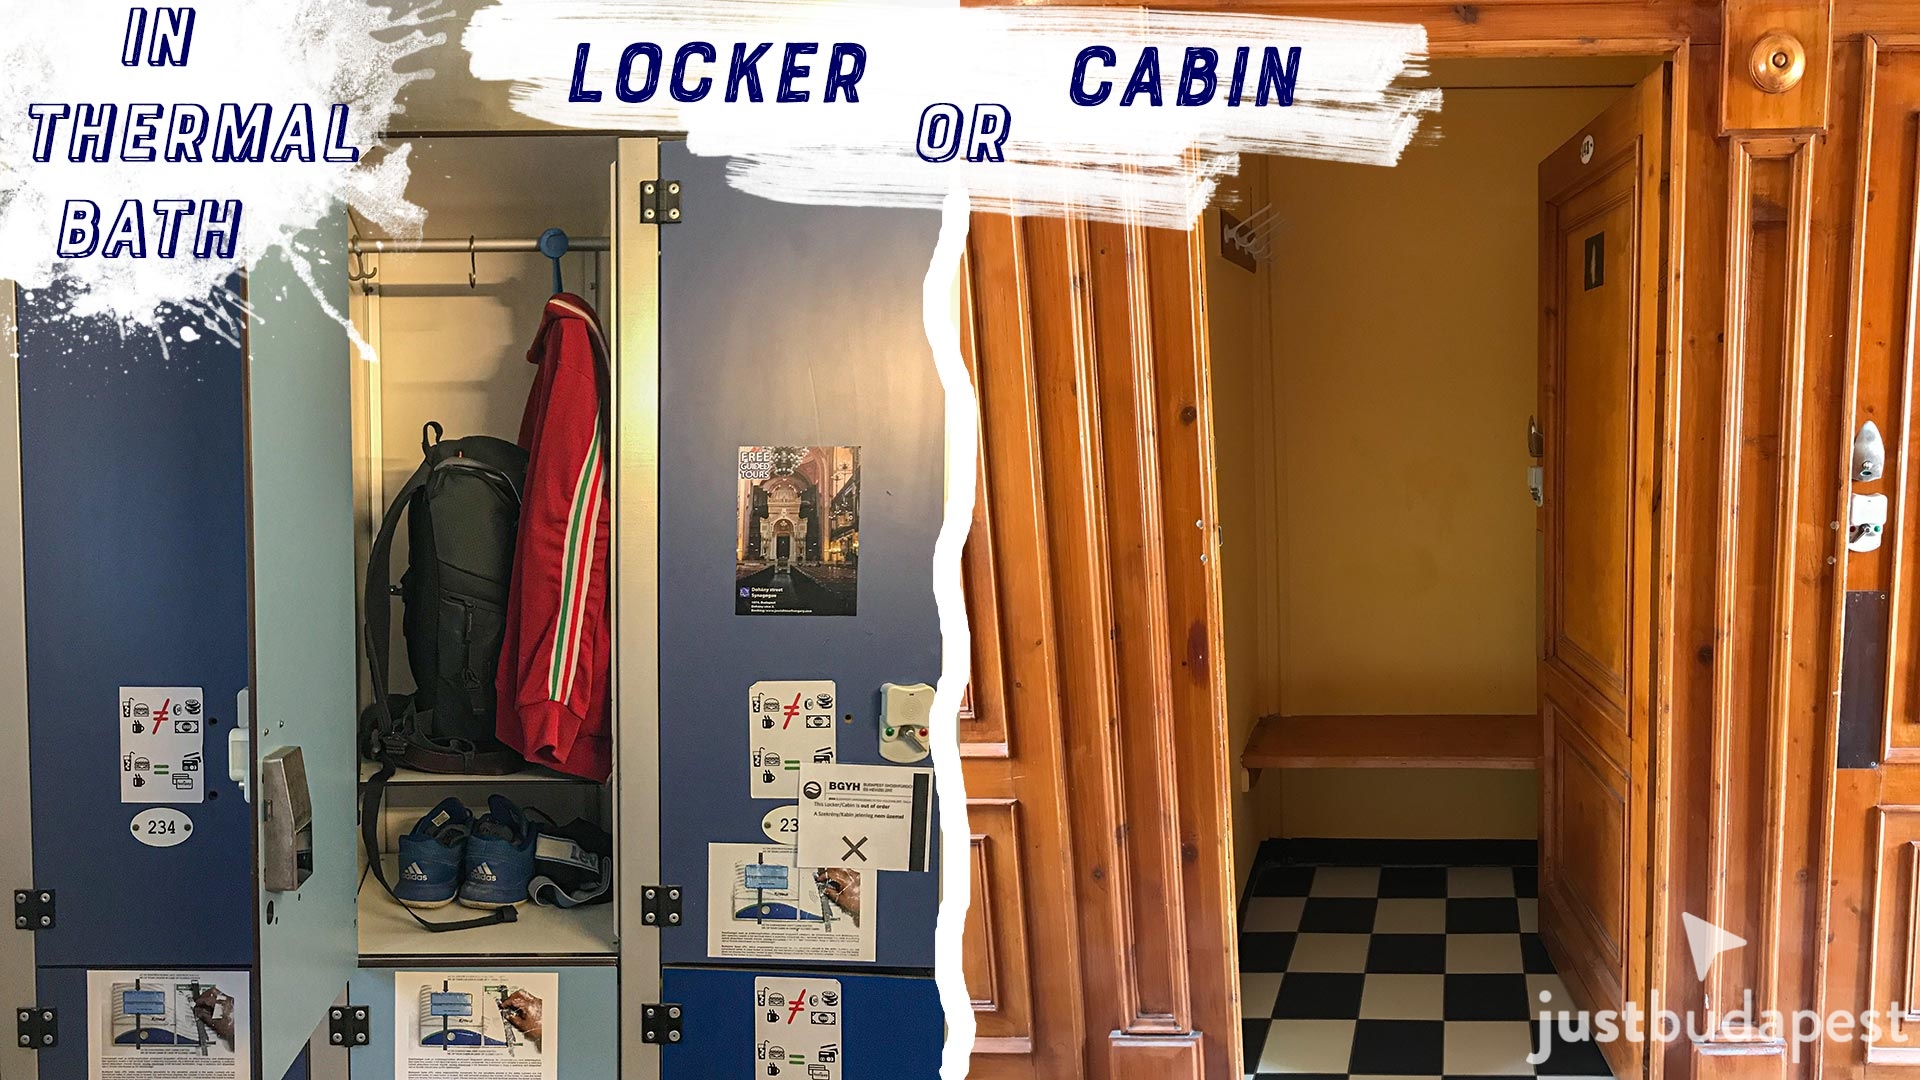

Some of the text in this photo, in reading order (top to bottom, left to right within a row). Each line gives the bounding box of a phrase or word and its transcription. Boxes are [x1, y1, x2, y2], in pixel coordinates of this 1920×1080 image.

[741, 452, 770, 462] FREE
[740, 462, 770, 471] GUIDED
[740, 470, 770, 479] TOURS
[829, 781, 860, 791] BGYH
[824, 801, 856, 810] Locker/Cabin
[148, 820, 176, 835] 234
[780, 818, 798, 833] 23
[401, 872, 428, 881] adidas
[471, 872, 498, 882] adidas
